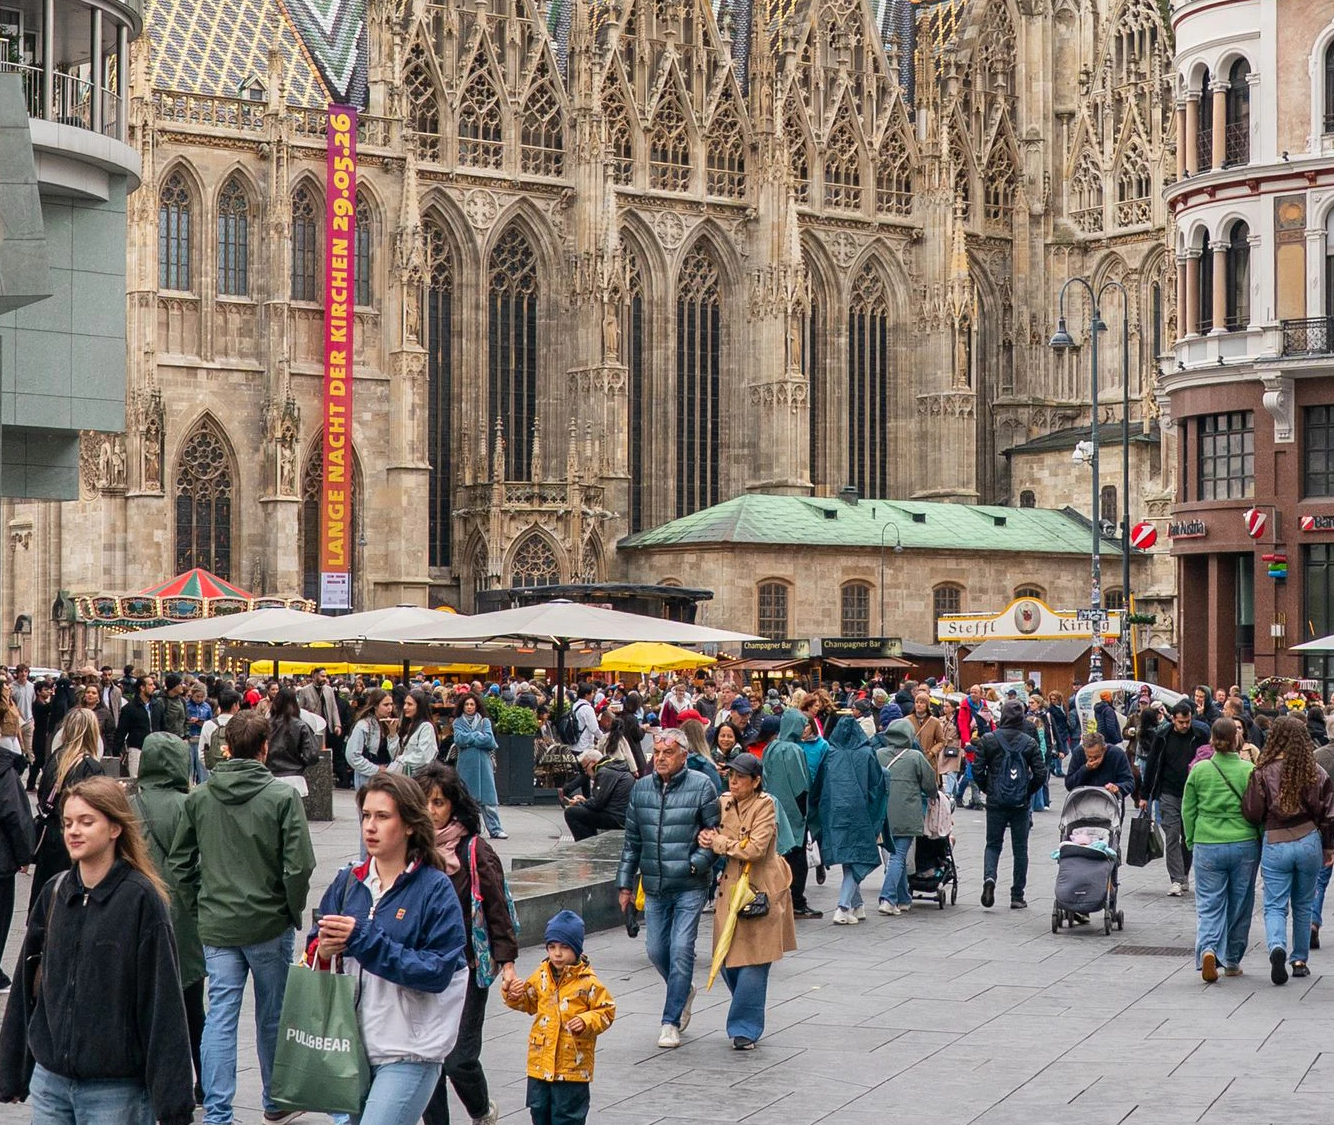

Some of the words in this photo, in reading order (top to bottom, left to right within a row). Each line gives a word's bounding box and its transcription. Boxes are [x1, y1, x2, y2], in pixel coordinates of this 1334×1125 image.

[330, 113, 355, 232] 29.05.26
[330, 239, 349, 343] KIRCHEN
[329, 350, 347, 396] DER
[328, 404, 346, 482] NACHT
[328, 491, 346, 567] LANGE
[1179, 520, 1204, 534] Austria
[823, 640, 868, 649] Champagner
[869, 640, 881, 648] Bar
[948, 620, 996, 637] Steffl
[1058, 618, 1110, 633] Kirtg
[744, 641, 780, 650] Champagner
[781, 641, 792, 649] Bar
[286, 1028, 351, 1052] PULL&BEAR
